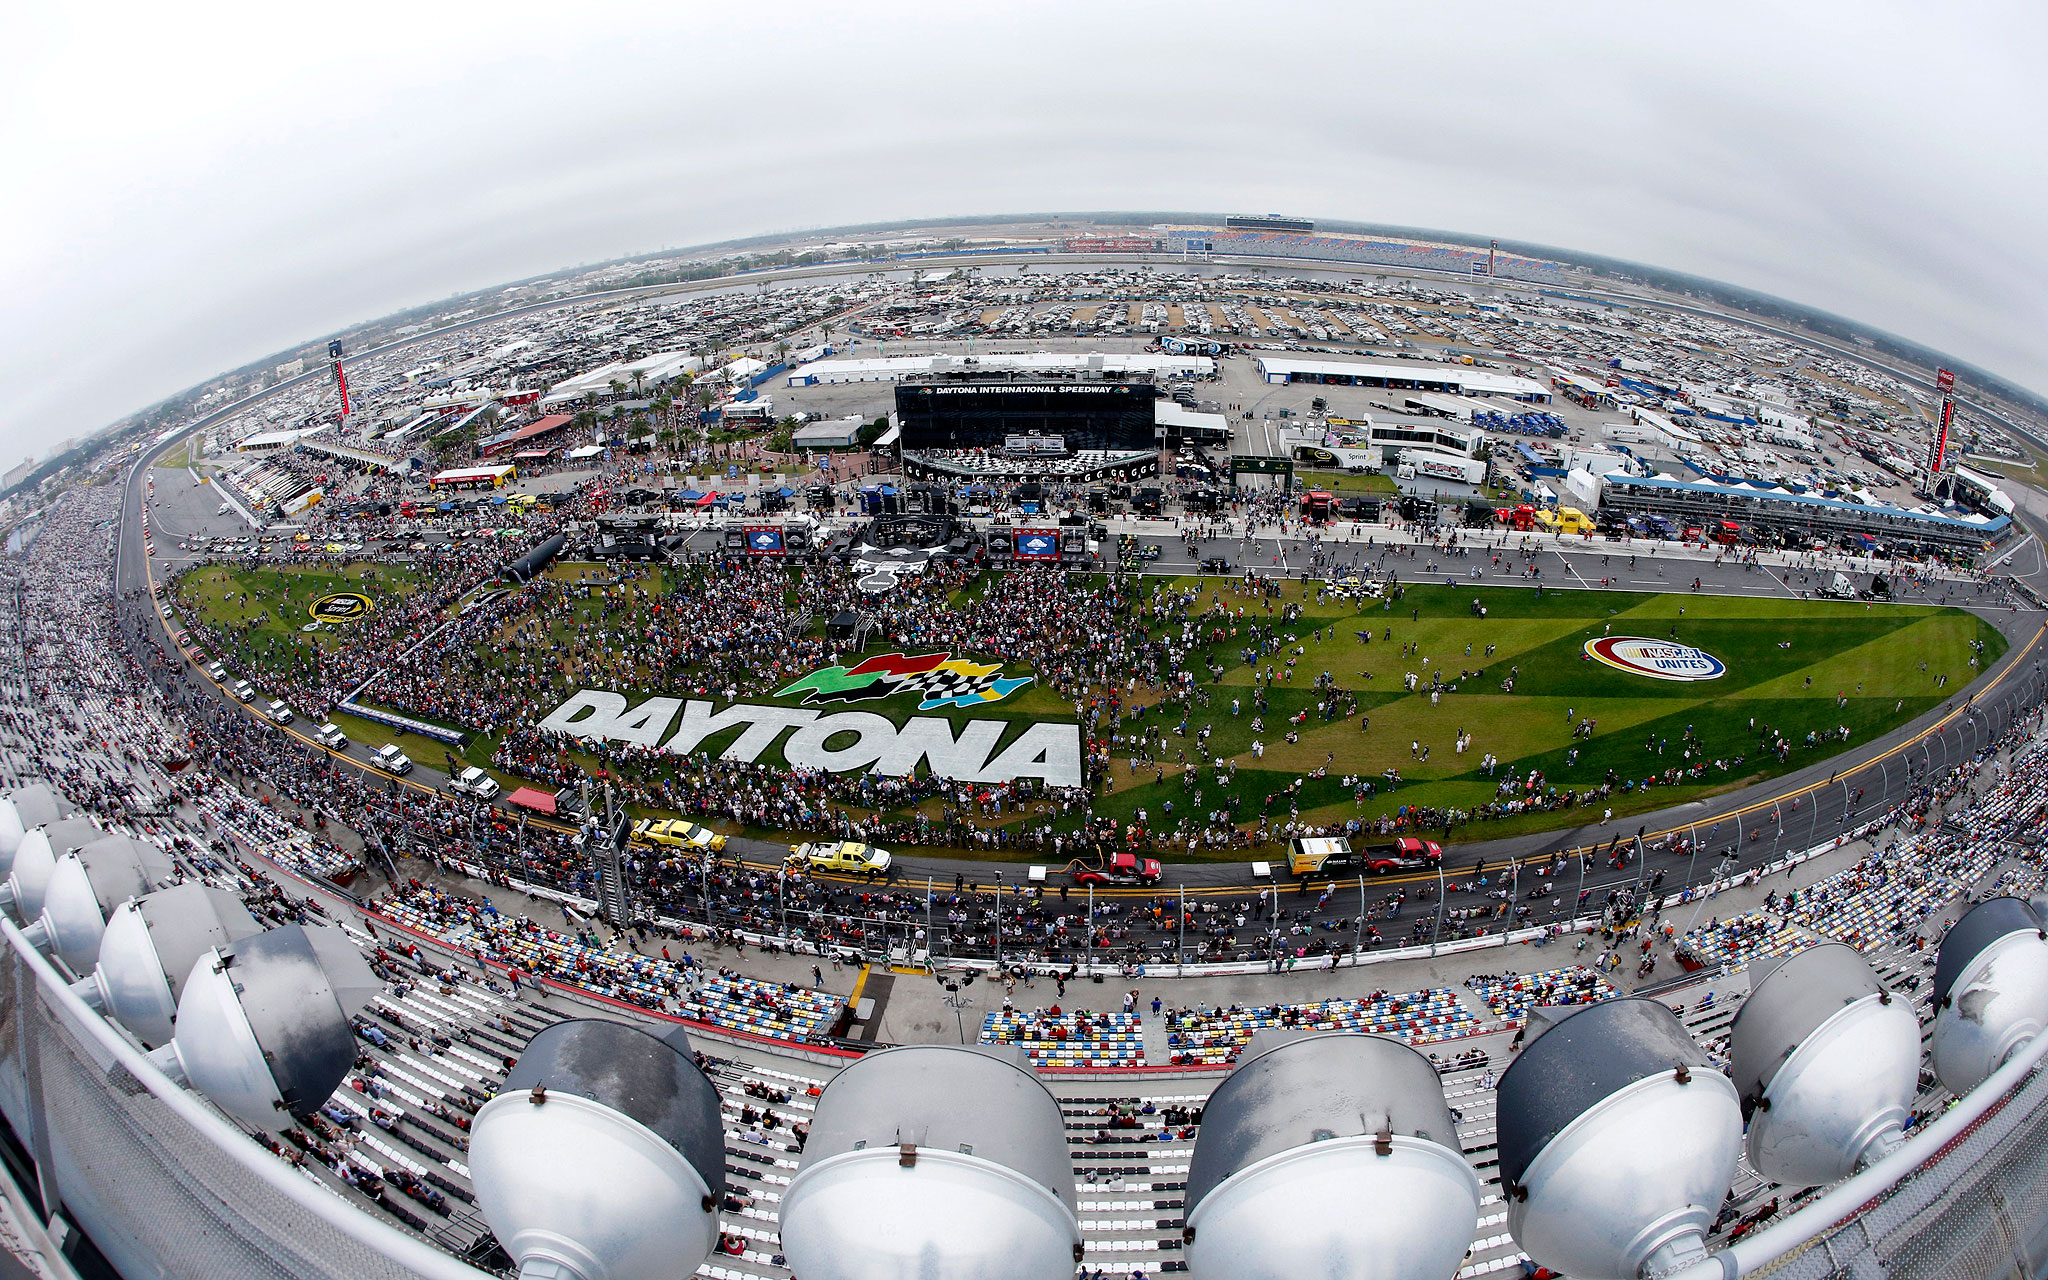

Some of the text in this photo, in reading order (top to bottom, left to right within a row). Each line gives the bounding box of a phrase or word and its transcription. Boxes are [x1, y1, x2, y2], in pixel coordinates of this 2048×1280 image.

[1131, 468, 1137, 476] G
[1140, 465, 1147, 474] G
[1149, 463, 1156, 471] G
[1646, 648, 1697, 659] NASCAR
[1656, 659, 1707, 669] UNITES
[538, 688, 1082, 788] DAYTONA
